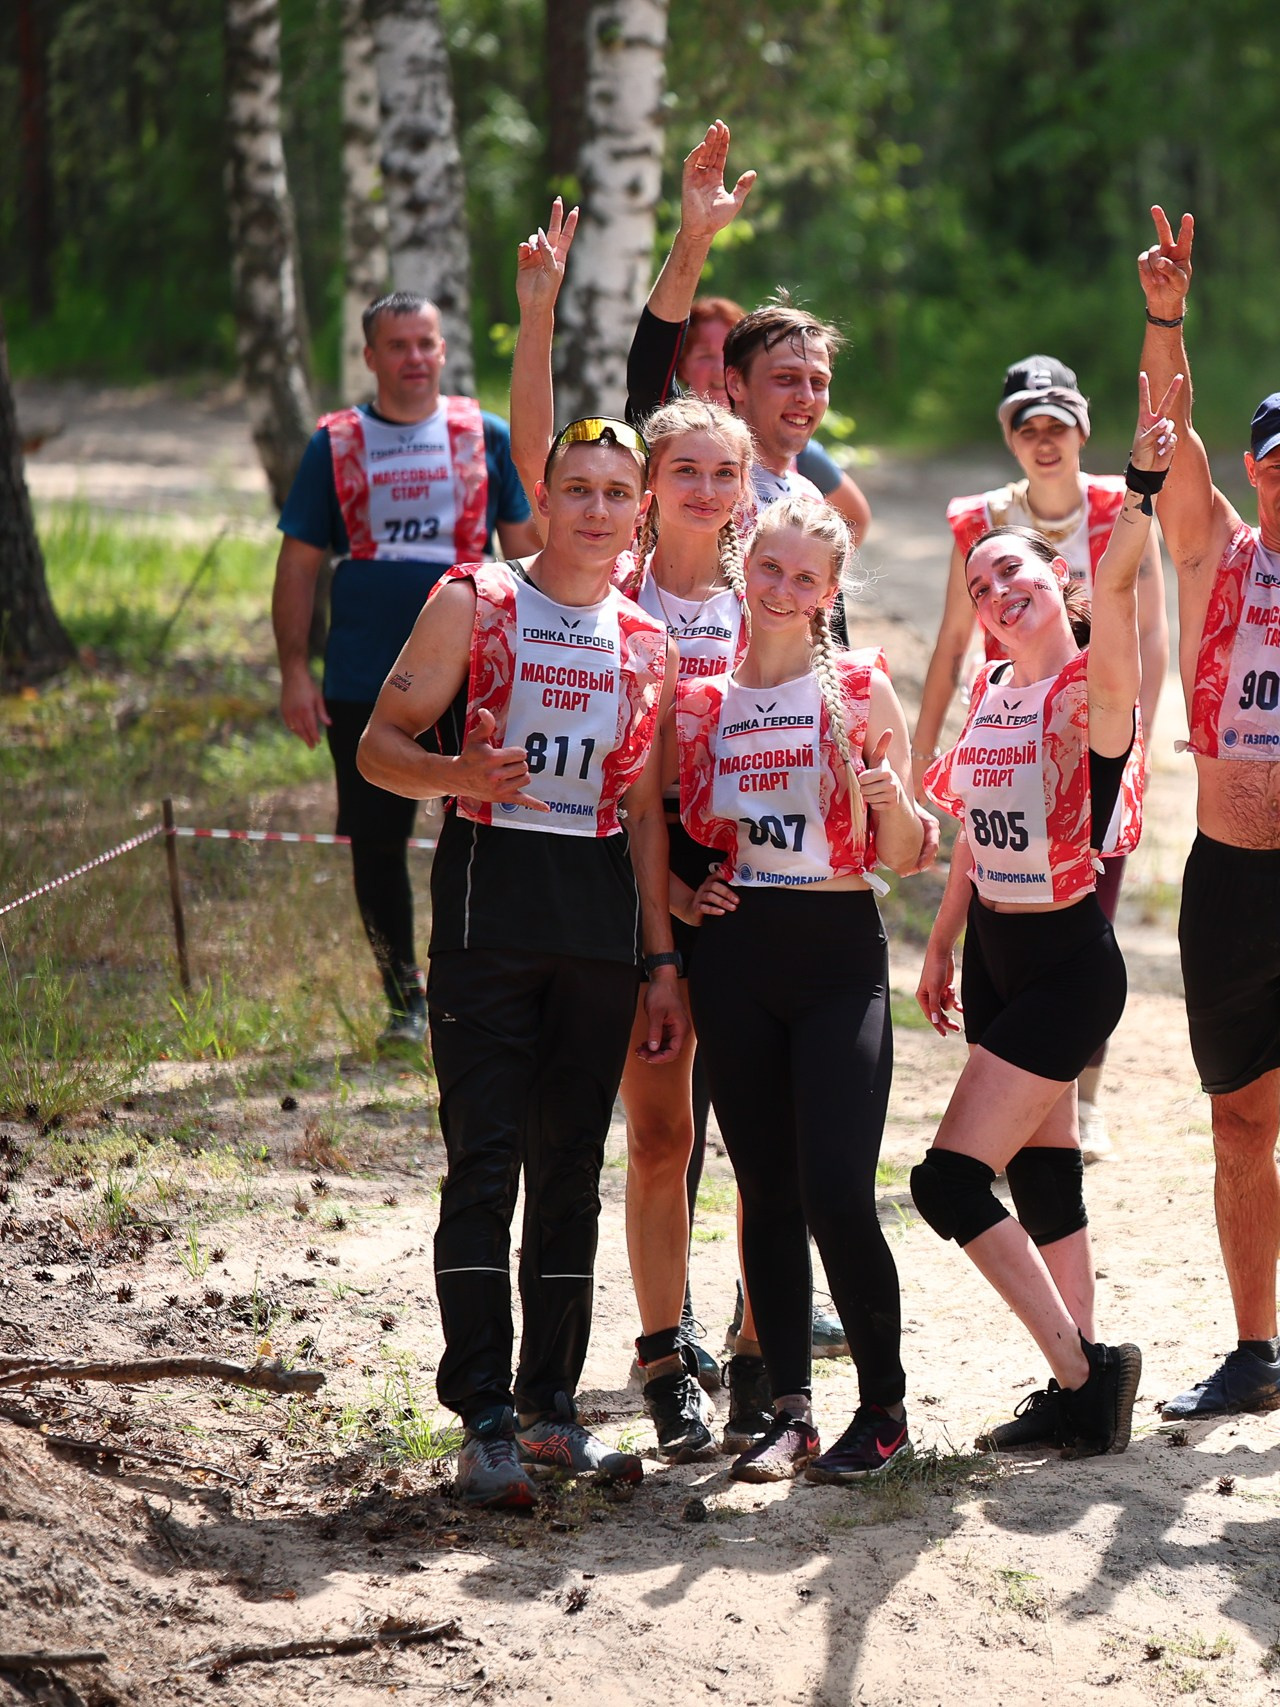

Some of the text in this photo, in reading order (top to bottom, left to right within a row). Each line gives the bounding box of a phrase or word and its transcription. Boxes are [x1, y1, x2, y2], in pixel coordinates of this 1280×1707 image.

[391, 484, 430, 501] СТАРТ
[384, 518, 440, 543] 703
[523, 628, 615, 650] ГОНКА ГЕРОЕВ
[684, 626, 732, 639] ГЕРОЕВ
[679, 656, 728, 677] ОВЫЙ
[520, 662, 615, 694] МАССОВЫЙ
[542, 688, 591, 712] СТАРТ
[722, 715, 814, 735] ГОНКА ГЕРОЕВ
[1006, 711, 1039, 726] ГЕРО
[525, 732, 596, 780] 811
[719, 744, 814, 776] МАССОВЫЙ
[957, 741, 1037, 766] МАССОВЫЙ
[738, 771, 790, 794] СТАРТ
[972, 768, 1015, 787] СТАРТ
[525, 800, 594, 816] РОМБАНК
[970, 809, 1029, 852] 805
[987, 869, 1047, 883] ГАЗПРОМБАНК
